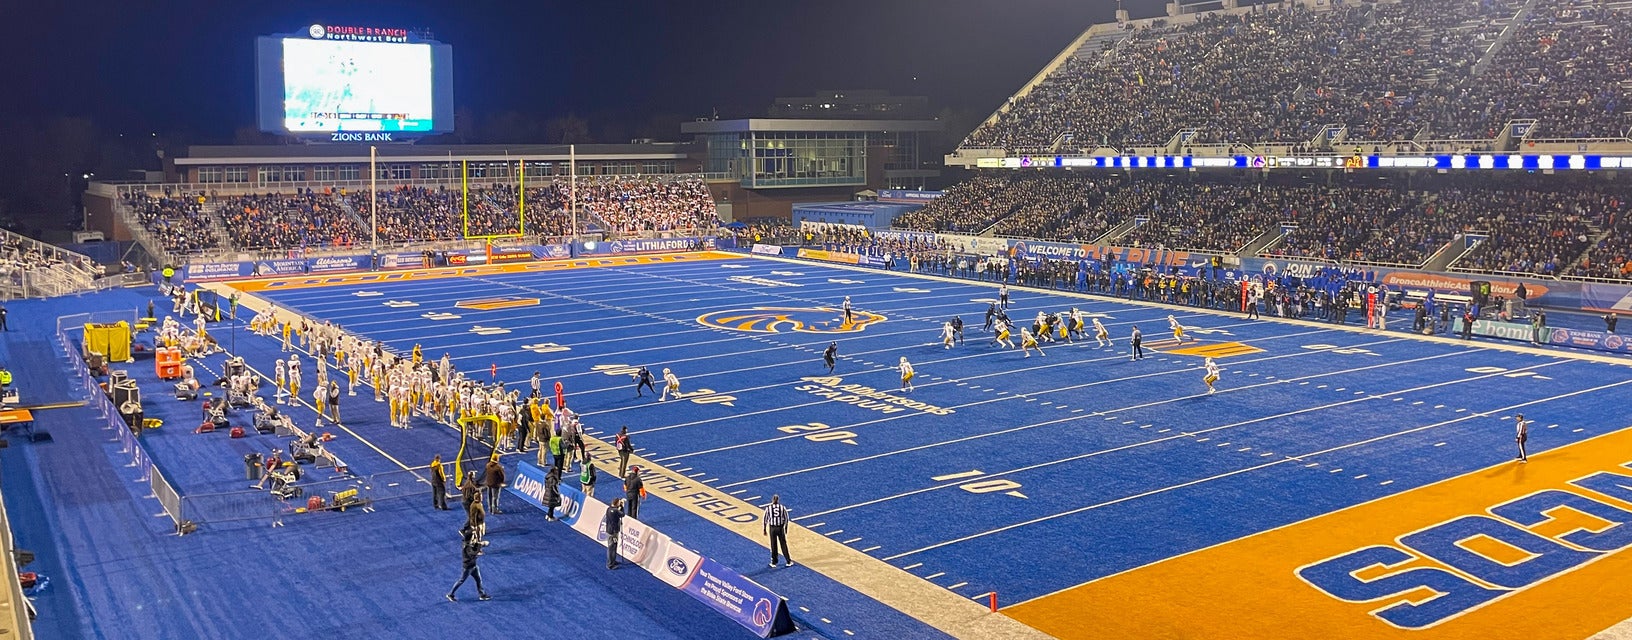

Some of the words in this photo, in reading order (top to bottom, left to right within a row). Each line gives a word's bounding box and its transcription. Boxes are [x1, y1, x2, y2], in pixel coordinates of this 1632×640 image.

[326, 25, 364, 34] DOUBLE
[374, 28, 406, 36] RANCH
[326, 34, 382, 42] Northwest
[331, 133, 362, 141] ZIONS
[364, 132, 392, 141] BANK
[1028, 244, 1072, 257] WELCOME
[1073, 248, 1086, 258] TO
[1286, 262, 1312, 275] JOIN
[796, 384, 905, 414] STADIUM
[838, 378, 955, 414] Albertsons
[777, 422, 858, 442] 20
[930, 469, 1022, 494] 10
[514, 473, 546, 504] CAMPIN
[554, 494, 580, 518] ORLD
[680, 492, 759, 524] FIELD
[628, 527, 640, 537] YOUR
[670, 558, 685, 574] Ford
[710, 583, 721, 594] Proud
[720, 588, 738, 602] Sponsors
[721, 580, 734, 592] Valley
[733, 586, 742, 596] Ford
[742, 590, 754, 602] Stores
[716, 595, 726, 606] State
